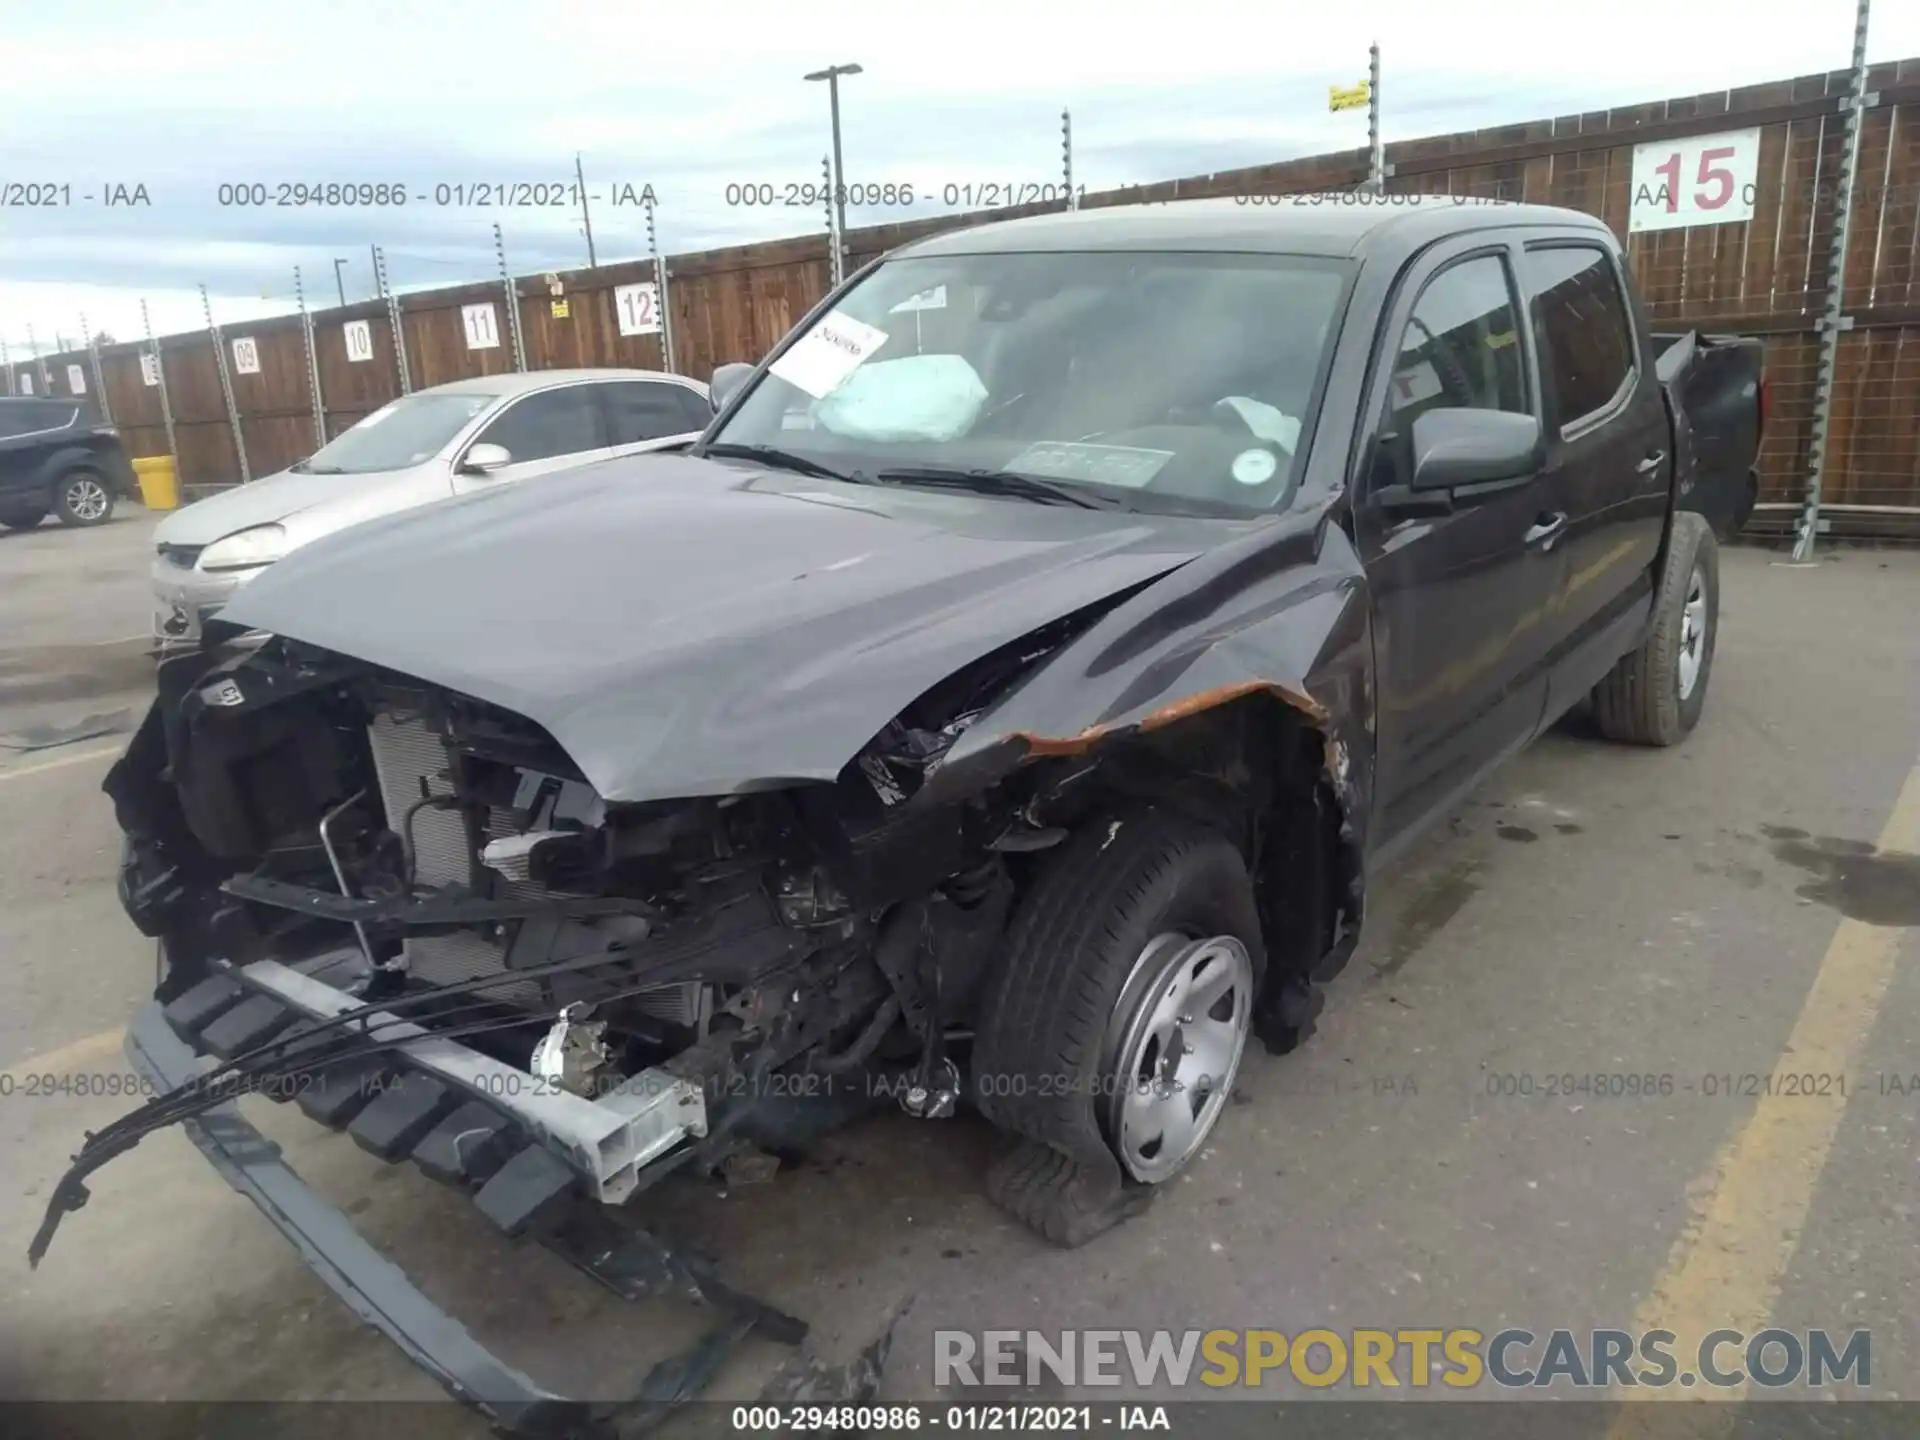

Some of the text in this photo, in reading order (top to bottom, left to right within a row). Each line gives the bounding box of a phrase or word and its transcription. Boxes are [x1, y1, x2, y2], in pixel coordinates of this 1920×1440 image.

[1655, 146, 1735, 213] 15
[468, 308, 491, 342] 11
[624, 290, 653, 327] 12
[349, 326, 368, 355] 10
